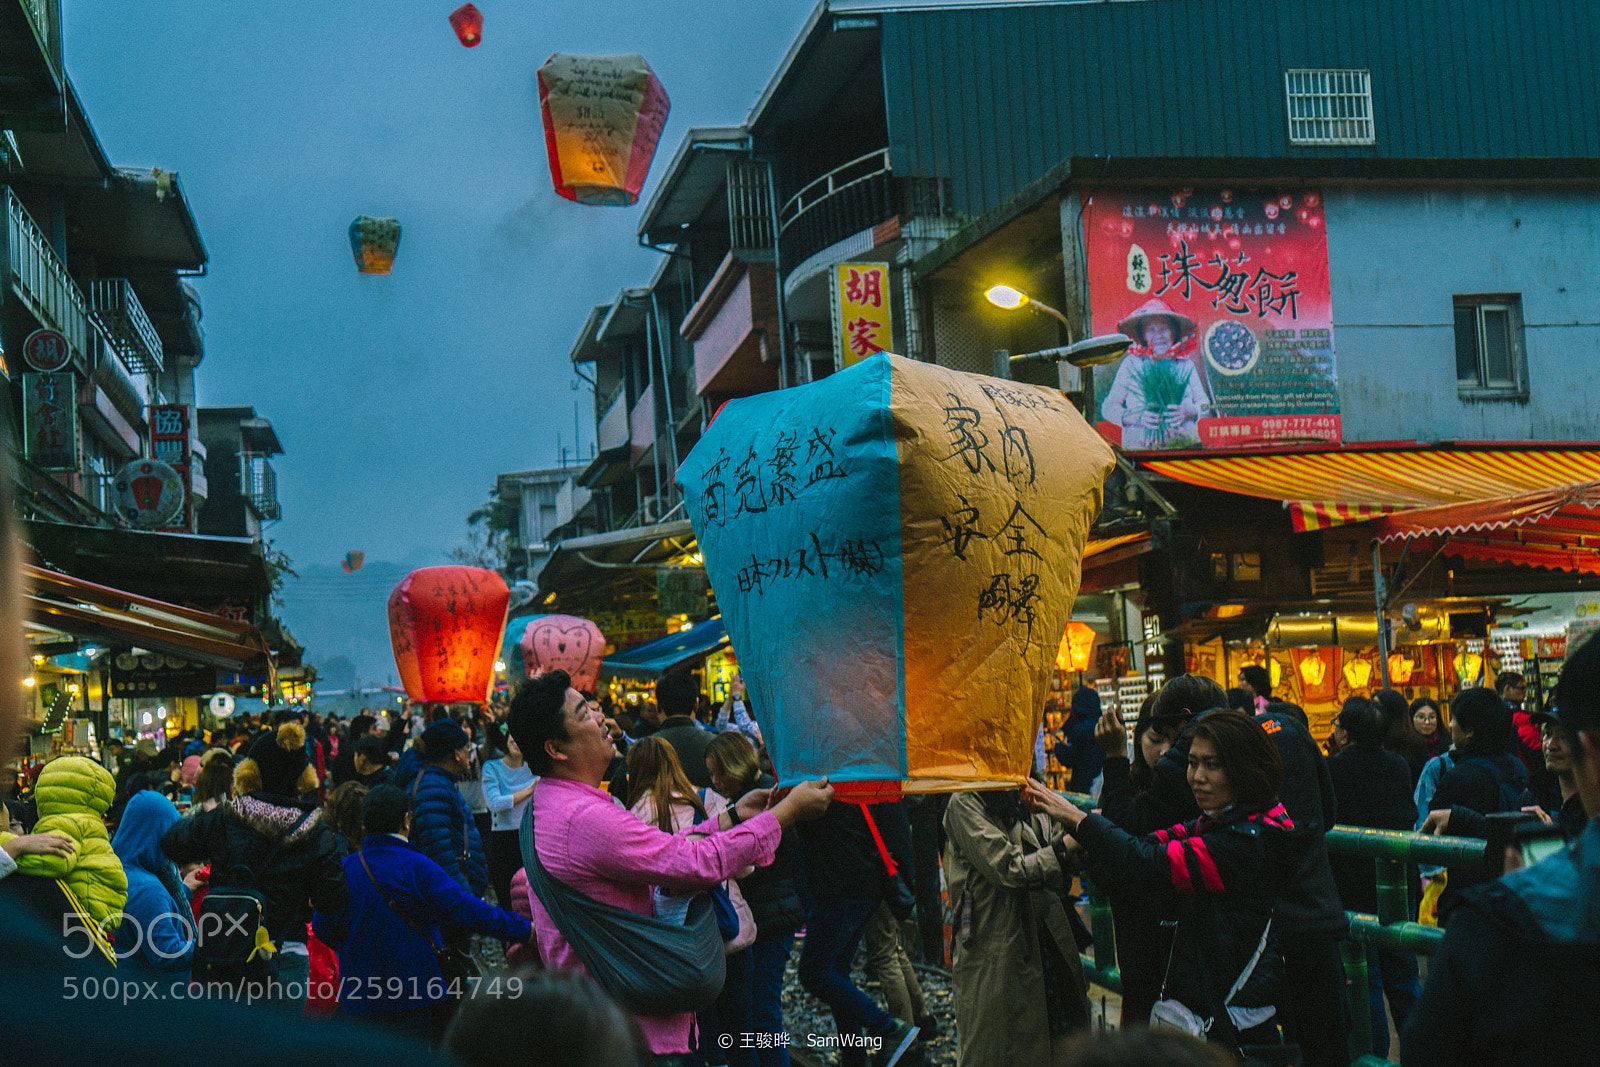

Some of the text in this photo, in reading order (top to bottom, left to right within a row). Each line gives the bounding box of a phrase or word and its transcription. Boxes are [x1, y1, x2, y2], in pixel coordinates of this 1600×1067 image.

[844, 267, 885, 357] 胡家
[36, 338, 59, 362] 胡
[940, 495, 1047, 562] 安全
